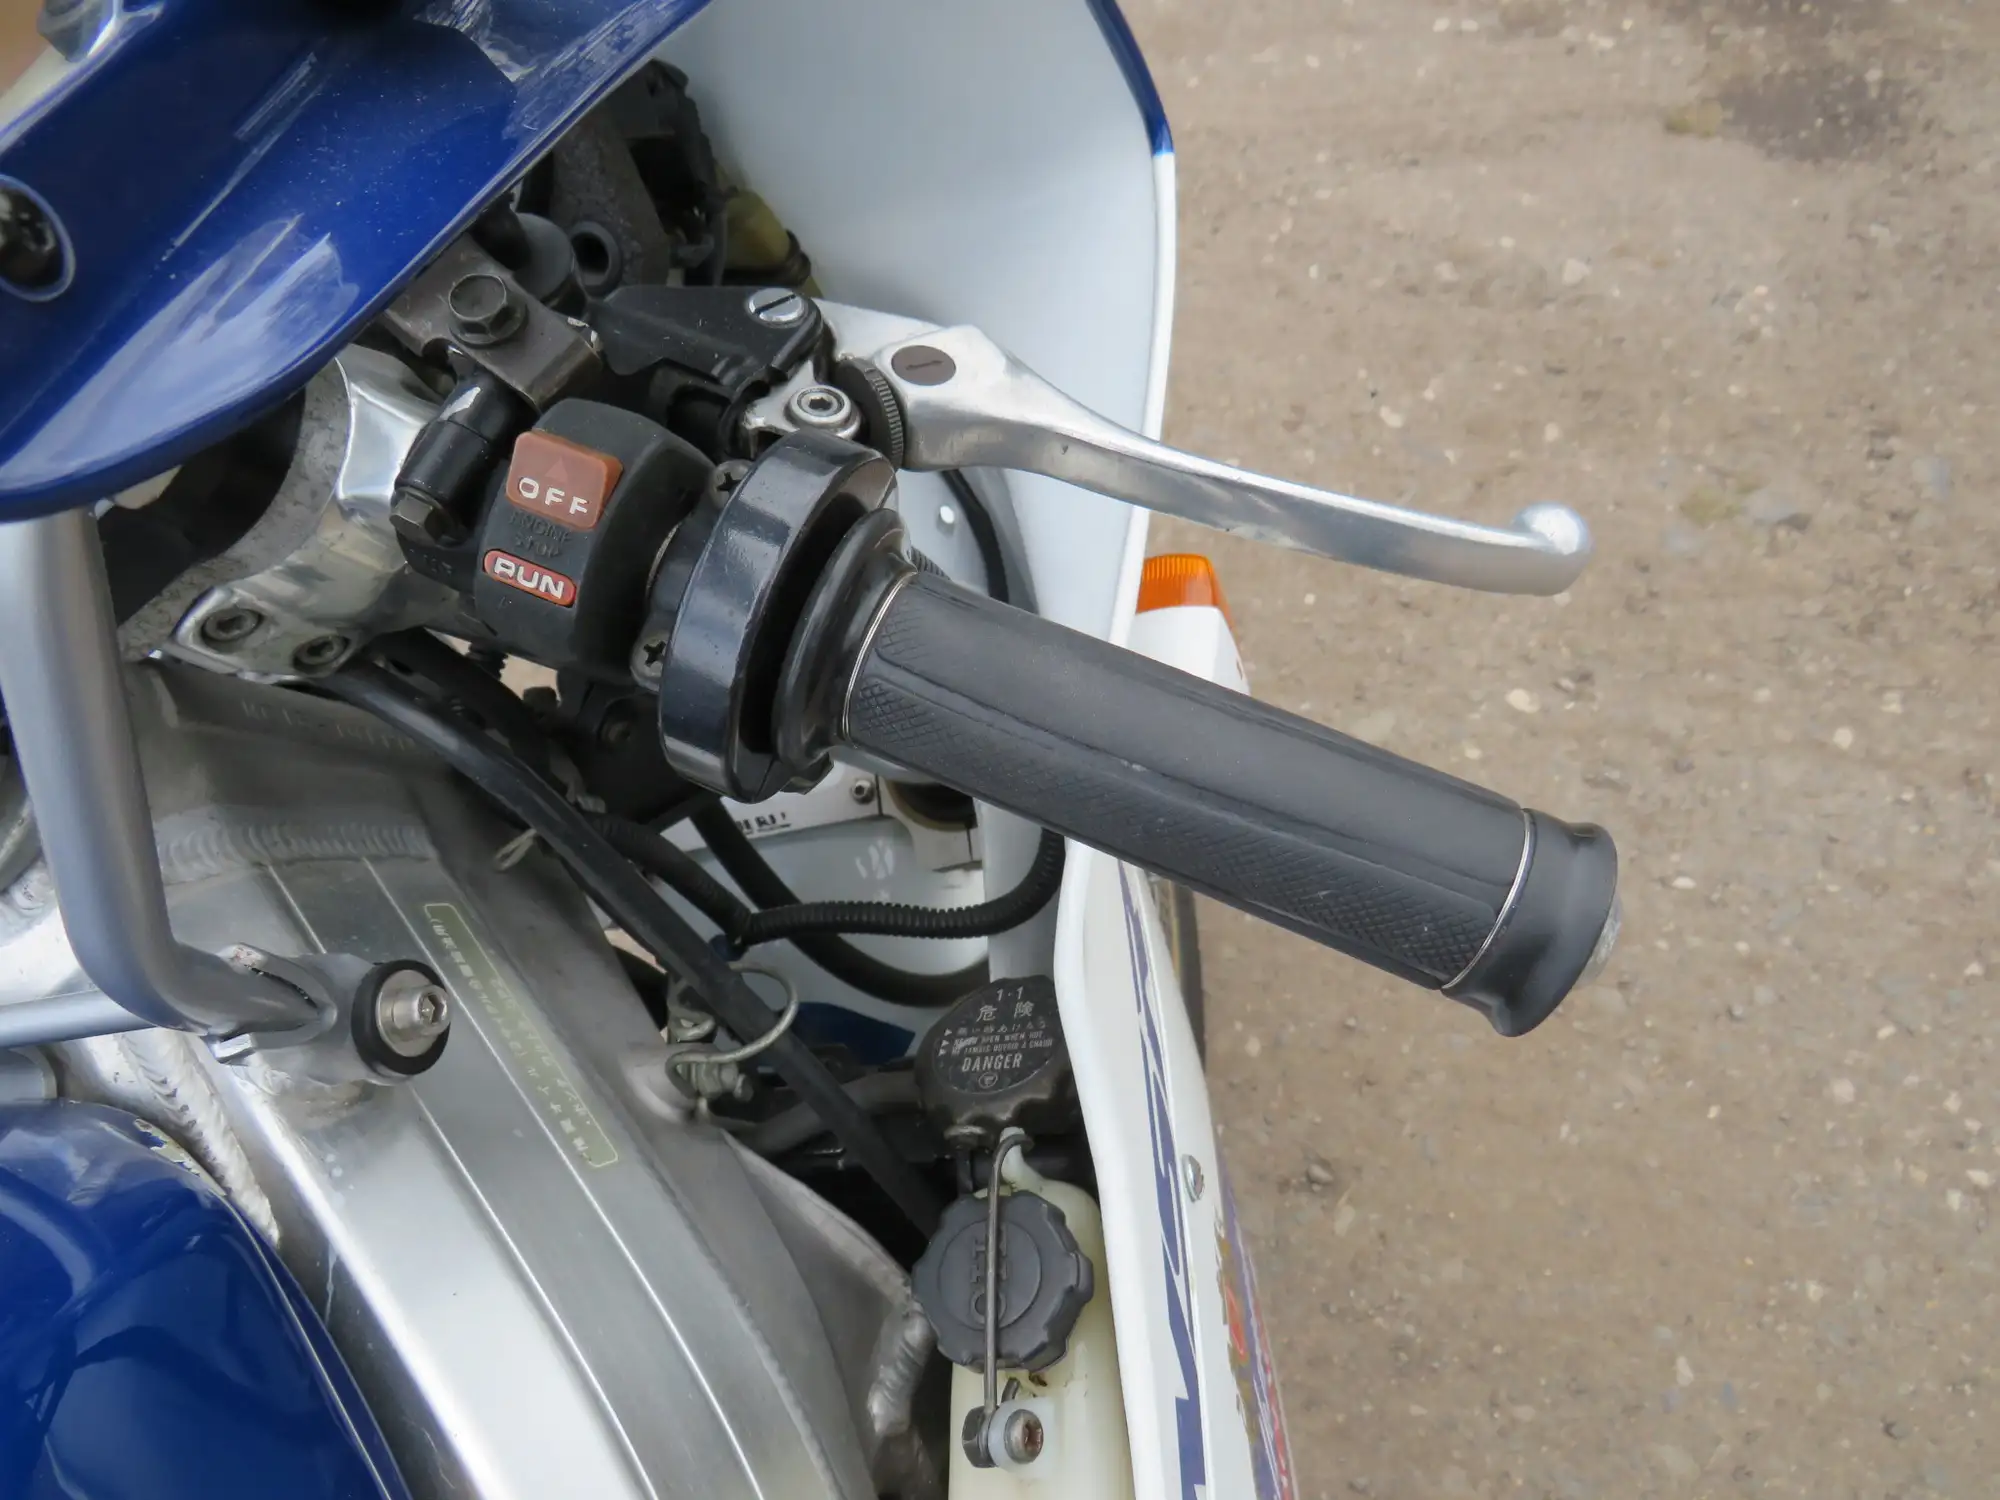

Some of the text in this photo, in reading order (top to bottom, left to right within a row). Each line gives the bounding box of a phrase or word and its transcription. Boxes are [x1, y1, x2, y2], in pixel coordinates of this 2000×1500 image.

[518, 477, 588, 515] OFF
[494, 556, 565, 599] RUN
[976, 1001, 1034, 1022] 危険
[961, 1053, 1022, 1073] DANGER
